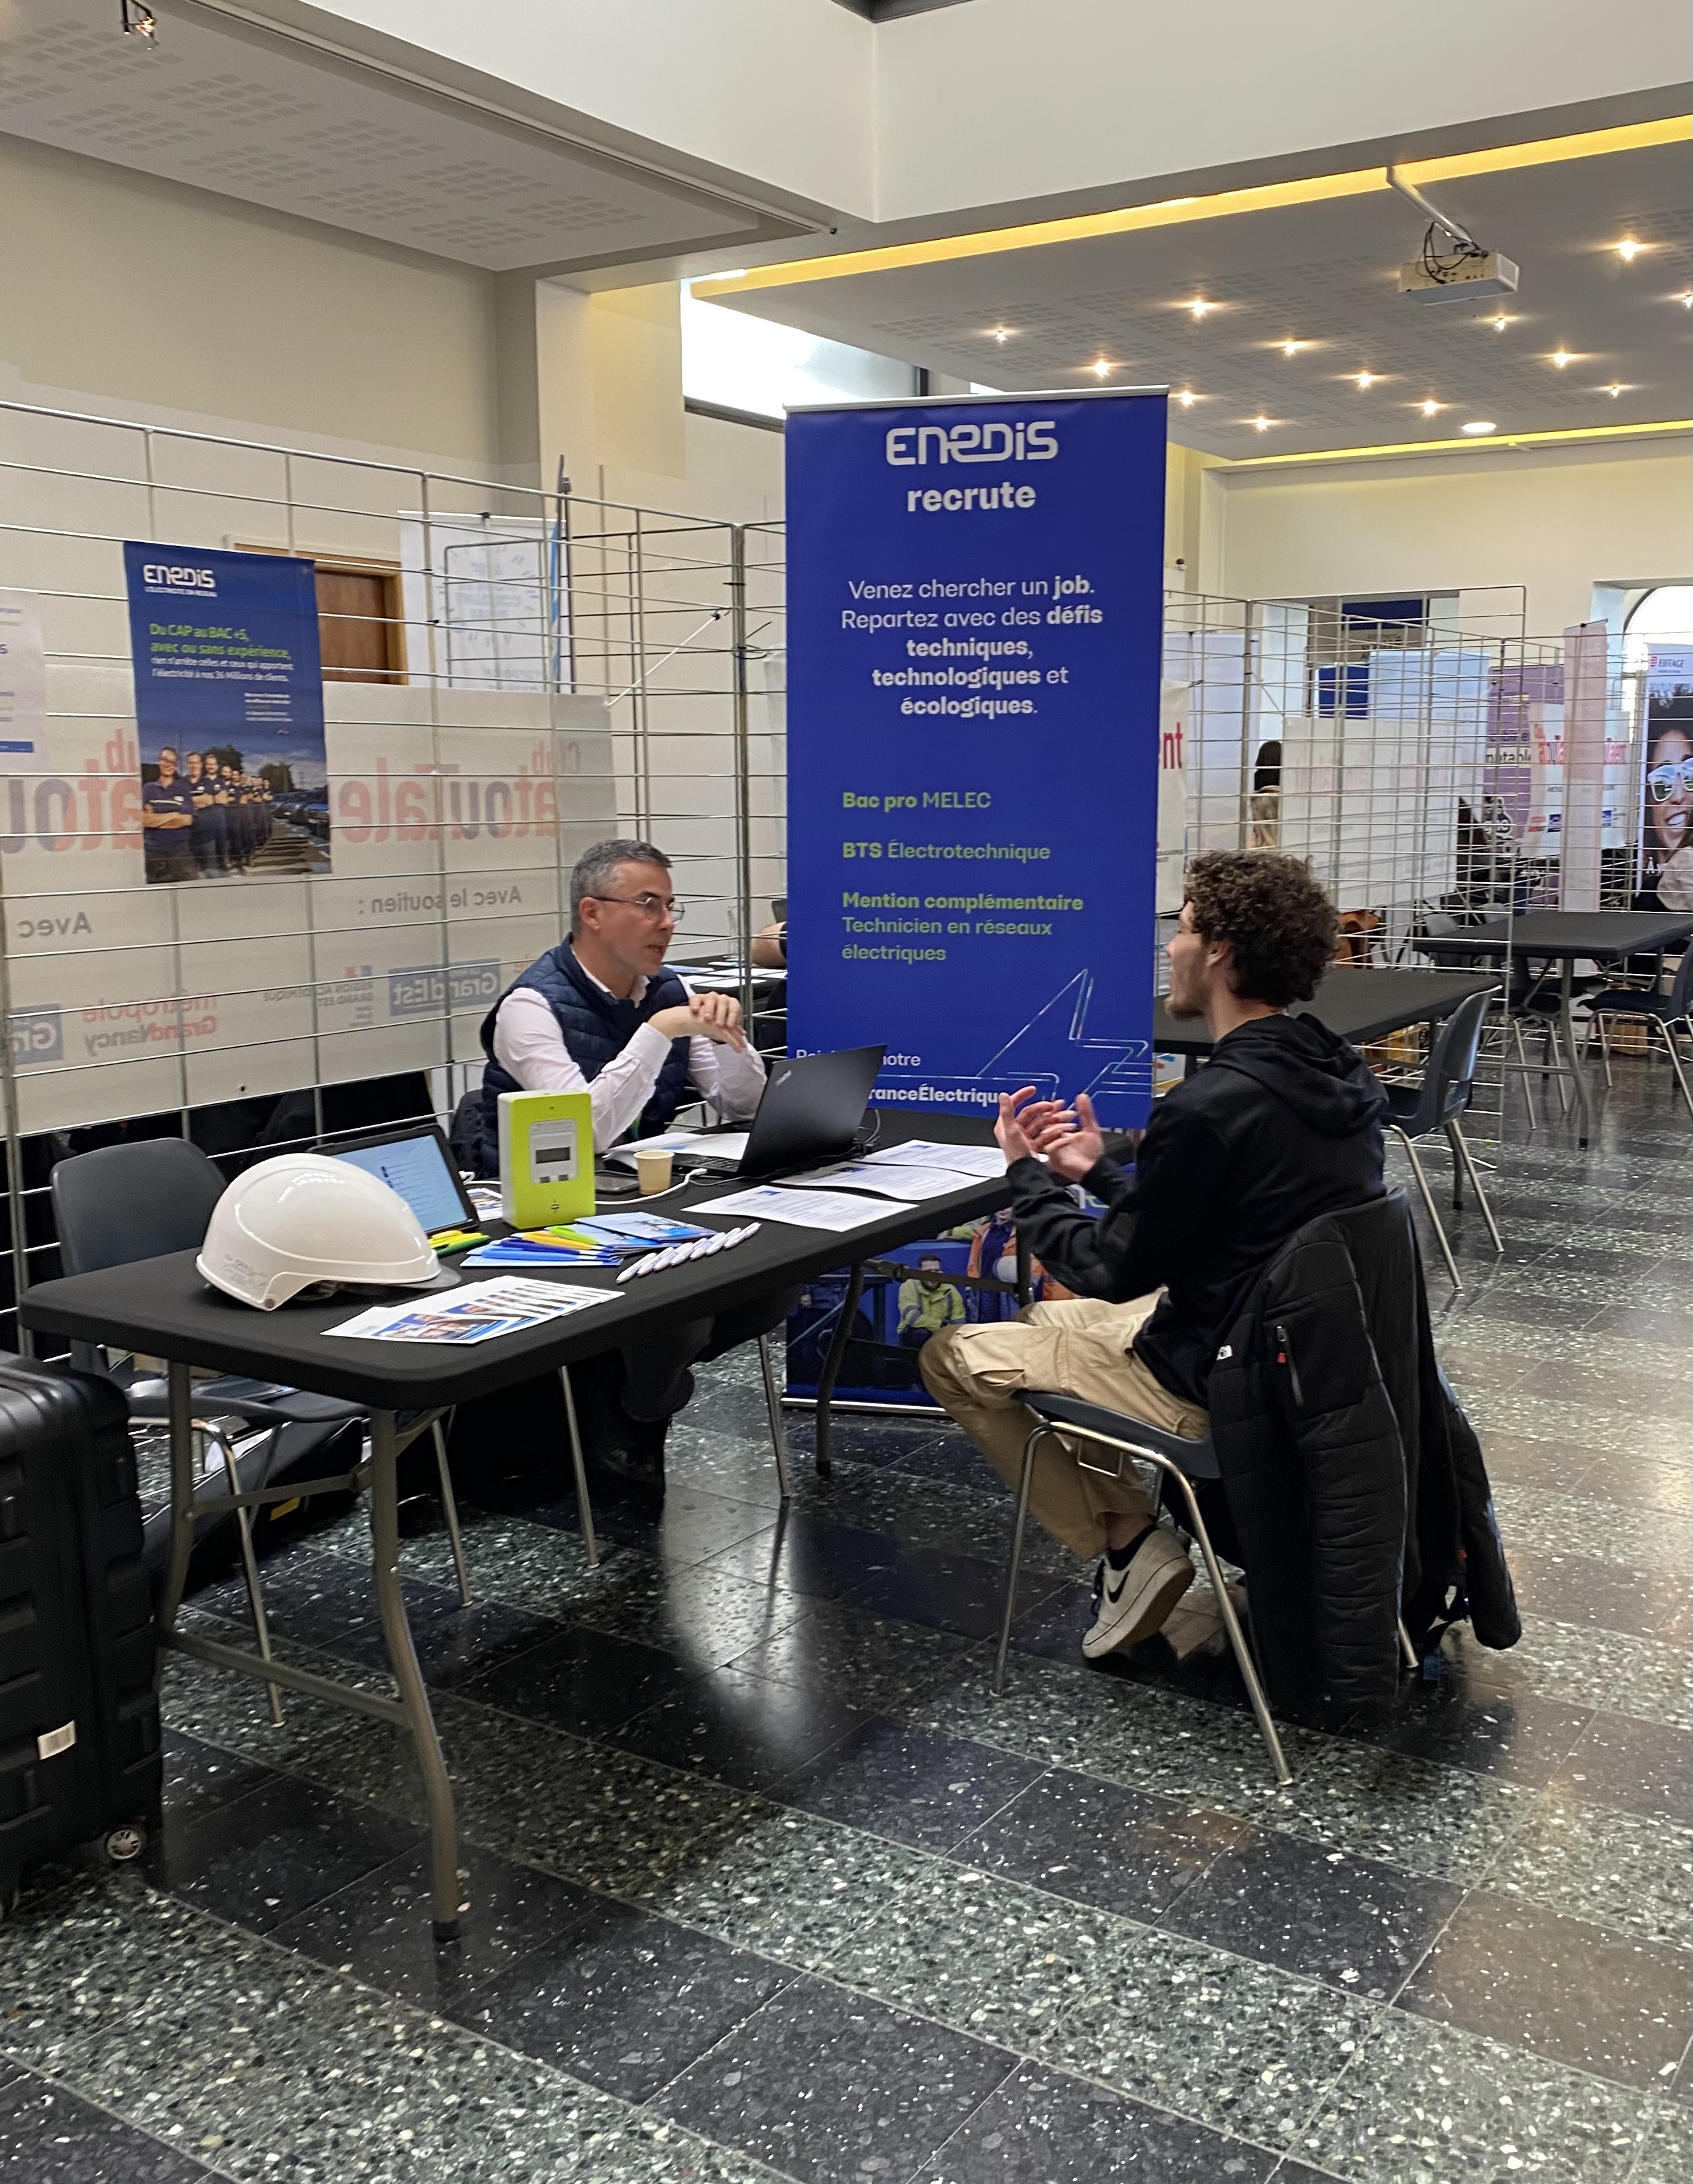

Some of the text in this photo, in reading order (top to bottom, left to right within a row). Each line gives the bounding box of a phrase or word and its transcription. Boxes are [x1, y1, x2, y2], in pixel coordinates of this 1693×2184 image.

[907, 481, 1036, 512] recrute
[848, 574, 1095, 600] Venez chercher un job.
[150, 623, 166, 635] Du
[168, 624, 193, 636] CAP
[193, 628, 208, 637] au
[209, 626, 232, 639] BAC
[842, 604, 1103, 634] Repartez avec des défis
[150, 642, 178, 653] avec
[181, 644, 197, 654] ou
[199, 645, 225, 655] sans
[906, 637, 1033, 662] techniques,
[871, 666, 1069, 690] technologiques et
[901, 696, 1038, 720] écologiques.
[843, 791, 991, 813] Bac pro MELEC
[842, 839, 1051, 864] BTS Électrotechnique
[842, 891, 1084, 914] Mention complémentaire
[842, 916, 1052, 935] Technicien en réseaux
[842, 944, 947, 965] électriques
[868, 1083, 999, 1107] ranceÉlectriqu
